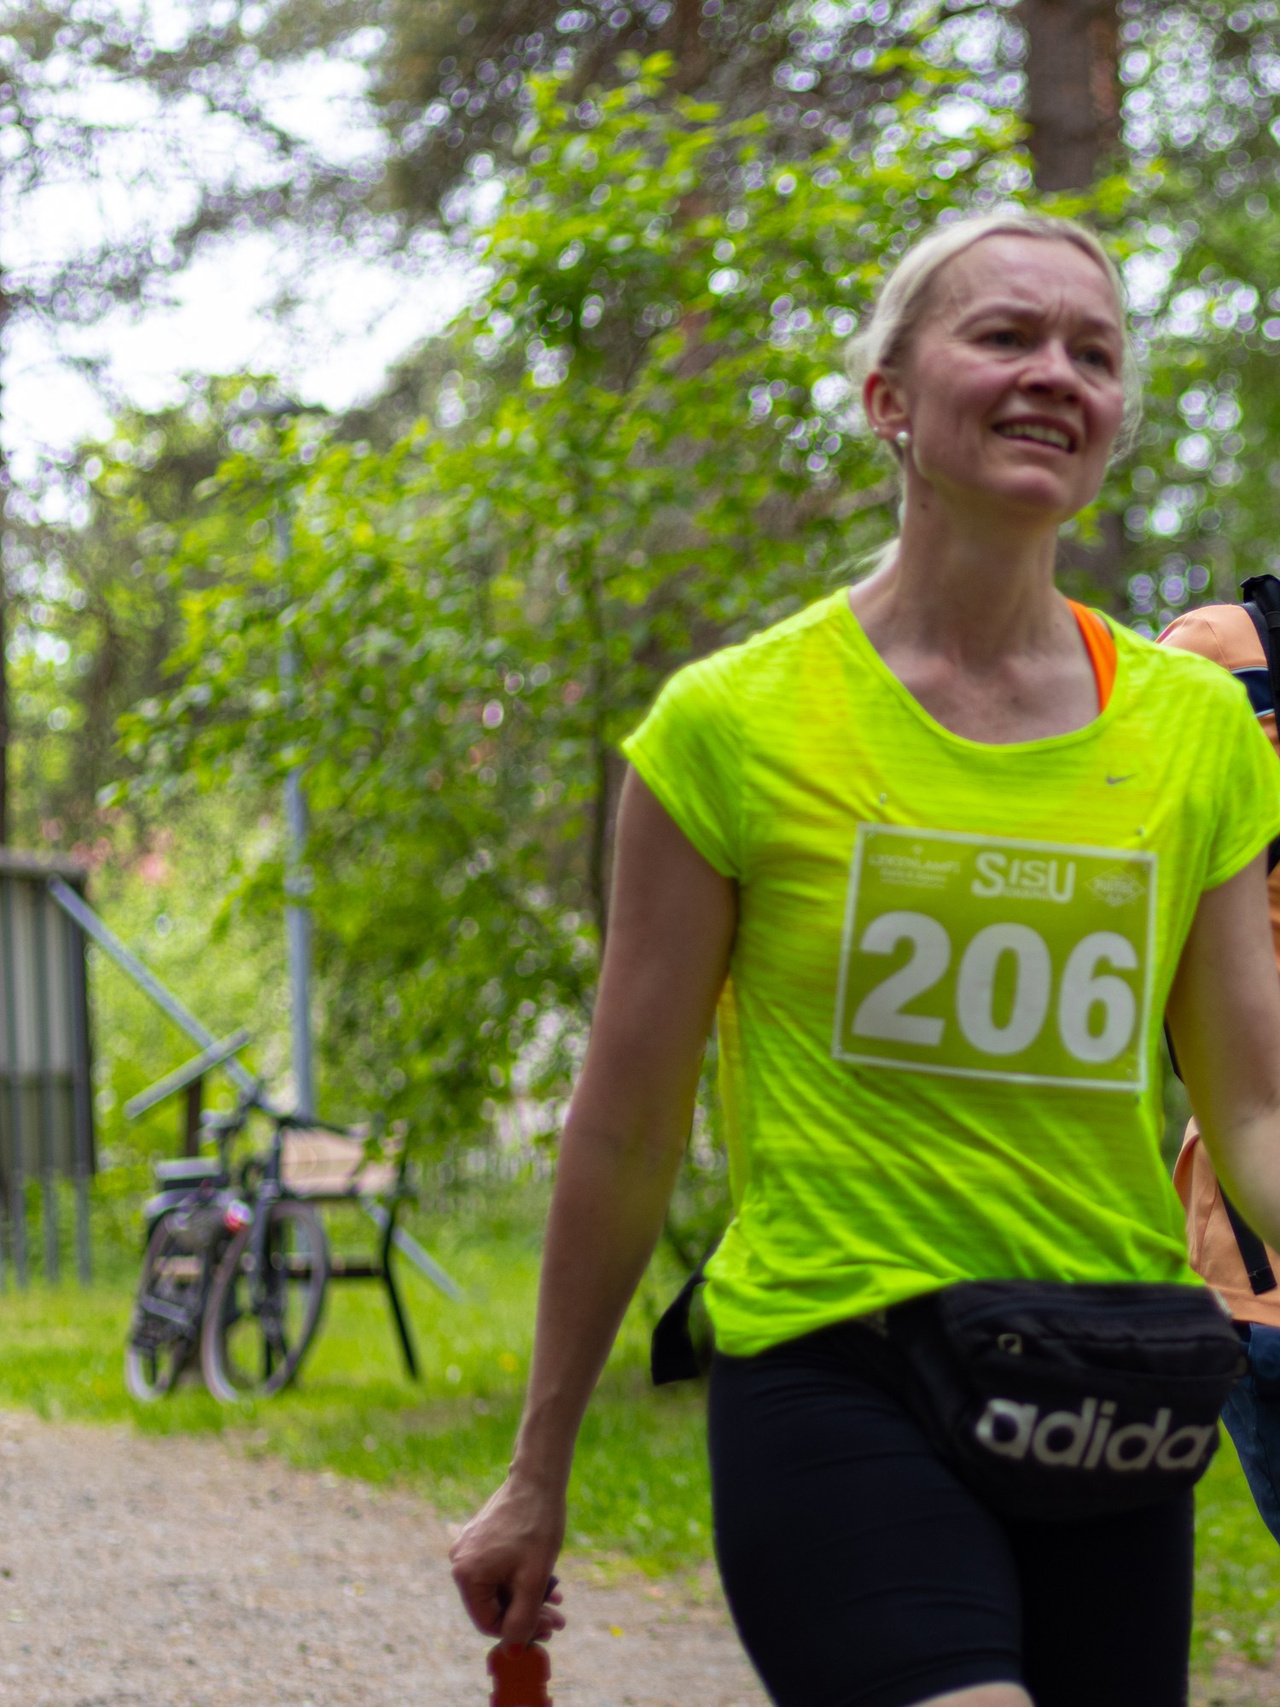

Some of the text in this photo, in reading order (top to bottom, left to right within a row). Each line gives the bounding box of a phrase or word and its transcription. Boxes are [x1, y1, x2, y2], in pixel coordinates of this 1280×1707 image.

[971, 852, 1076, 904] SISU
[852, 910, 1138, 1064] 206
[976, 1397, 1216, 1471] adida
